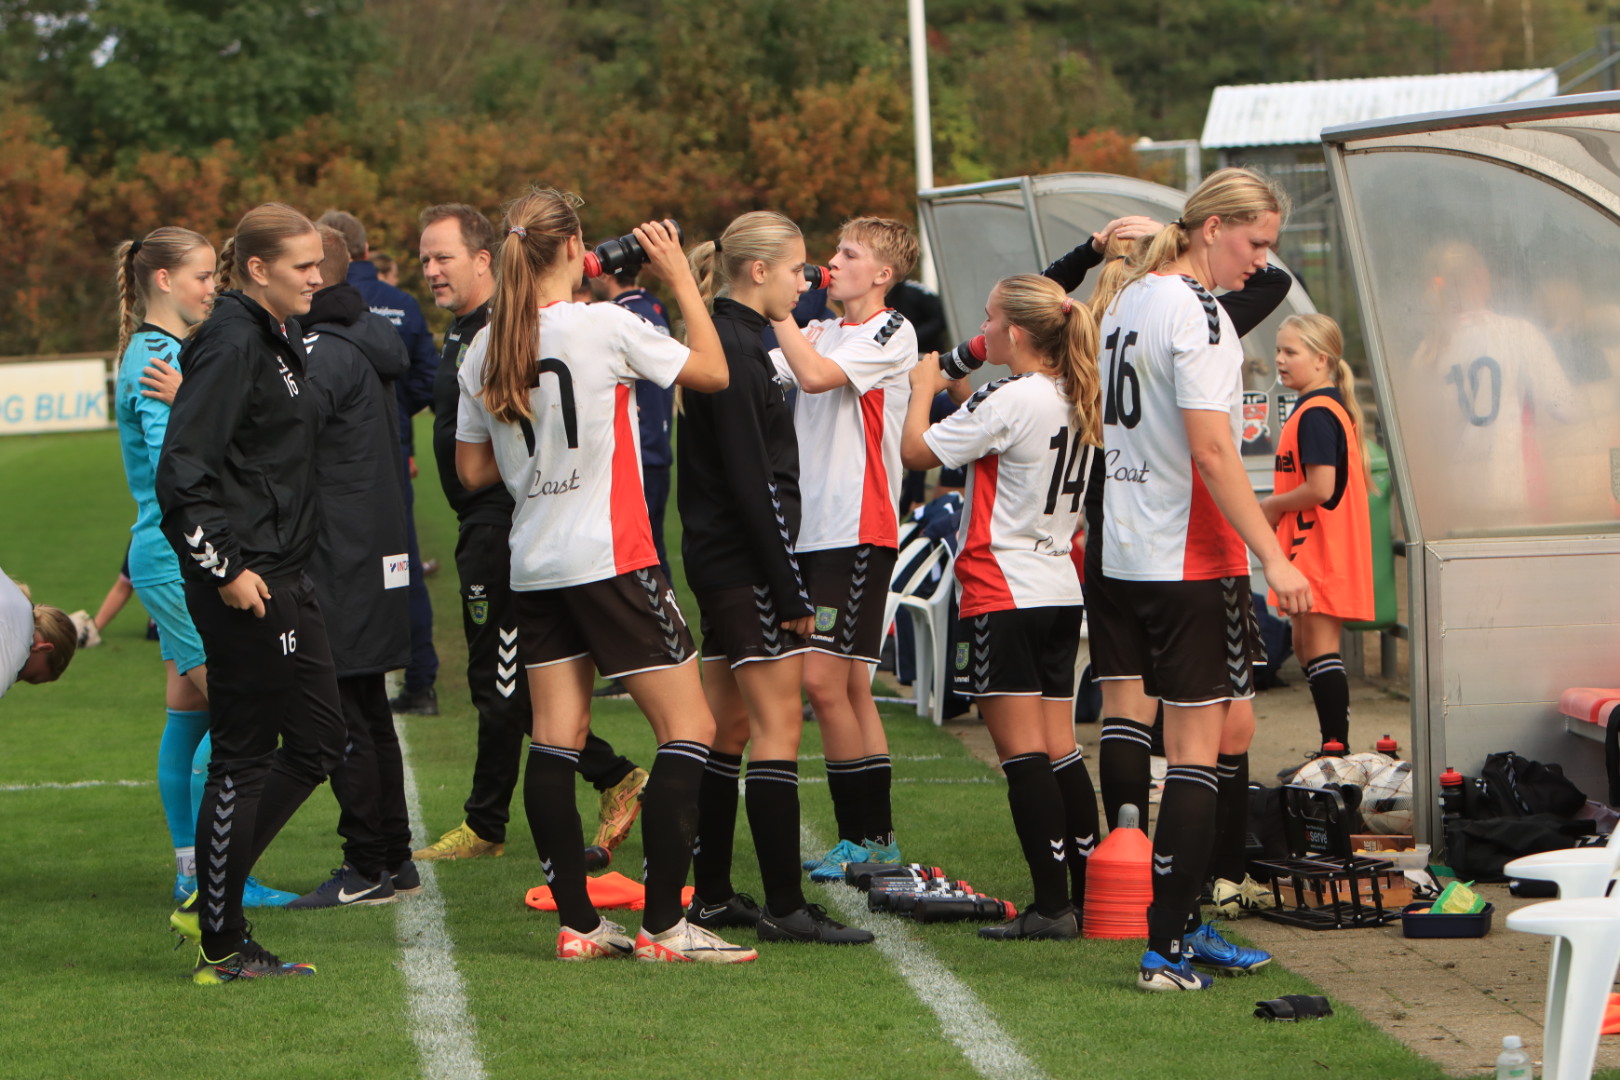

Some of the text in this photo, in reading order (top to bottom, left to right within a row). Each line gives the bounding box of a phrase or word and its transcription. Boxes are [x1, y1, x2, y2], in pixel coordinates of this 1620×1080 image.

[283, 372, 299, 397] 16
[1104, 326, 1141, 429] 16
[1445, 356, 1502, 427] 10
[0, 391, 105, 424] G BLIK
[1043, 426, 1085, 514] 14
[279, 629, 297, 656] 16
